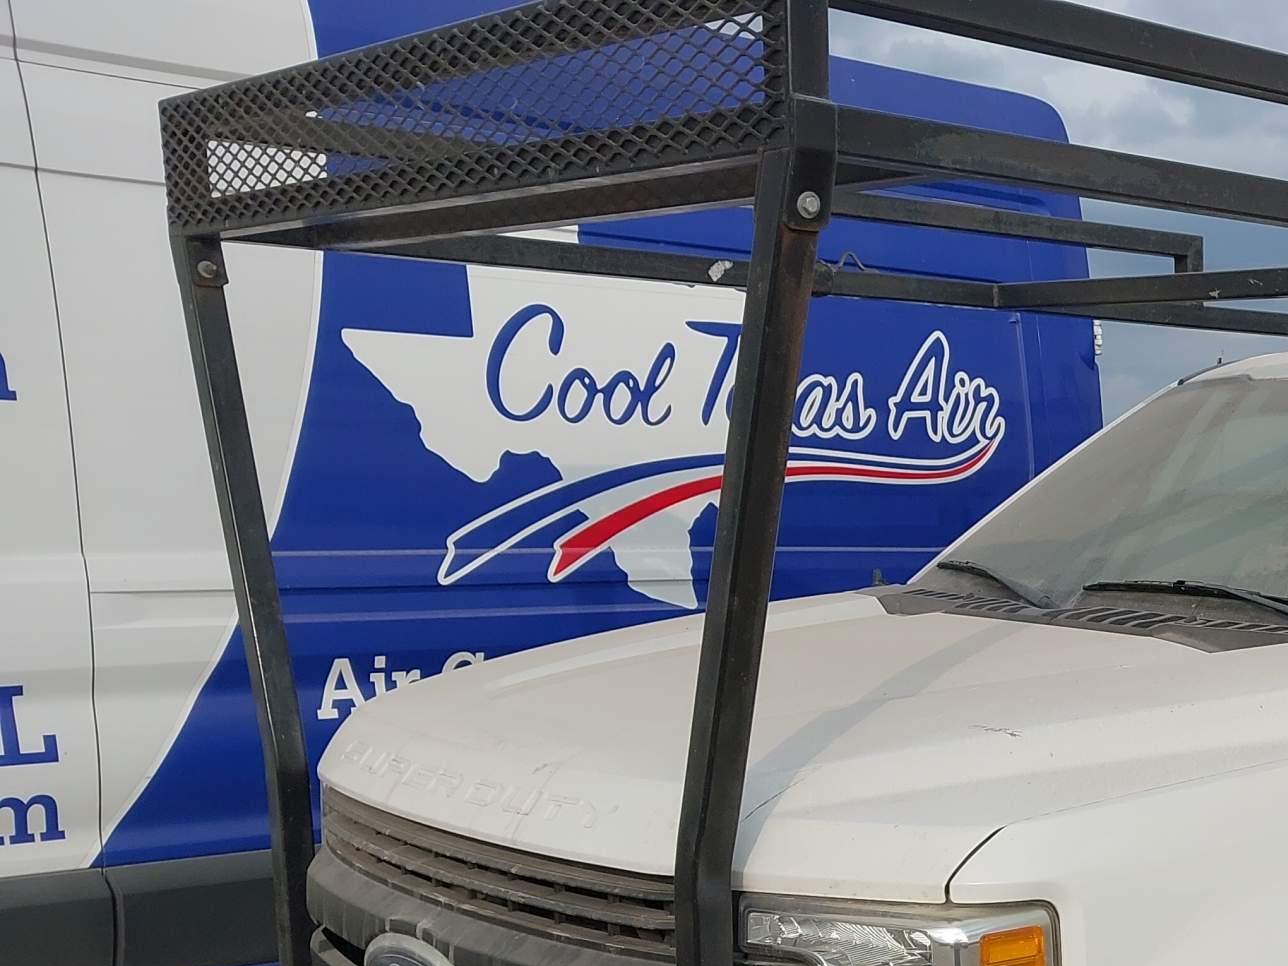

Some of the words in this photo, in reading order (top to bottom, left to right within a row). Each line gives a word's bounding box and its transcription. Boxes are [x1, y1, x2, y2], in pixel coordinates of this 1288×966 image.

[485, 303, 676, 426] Cool
[686, 320, 878, 440] Tas
[888, 330, 1006, 444] Air
[341, 739, 463, 799] SUPER
[464, 777, 620, 830] DUTY
